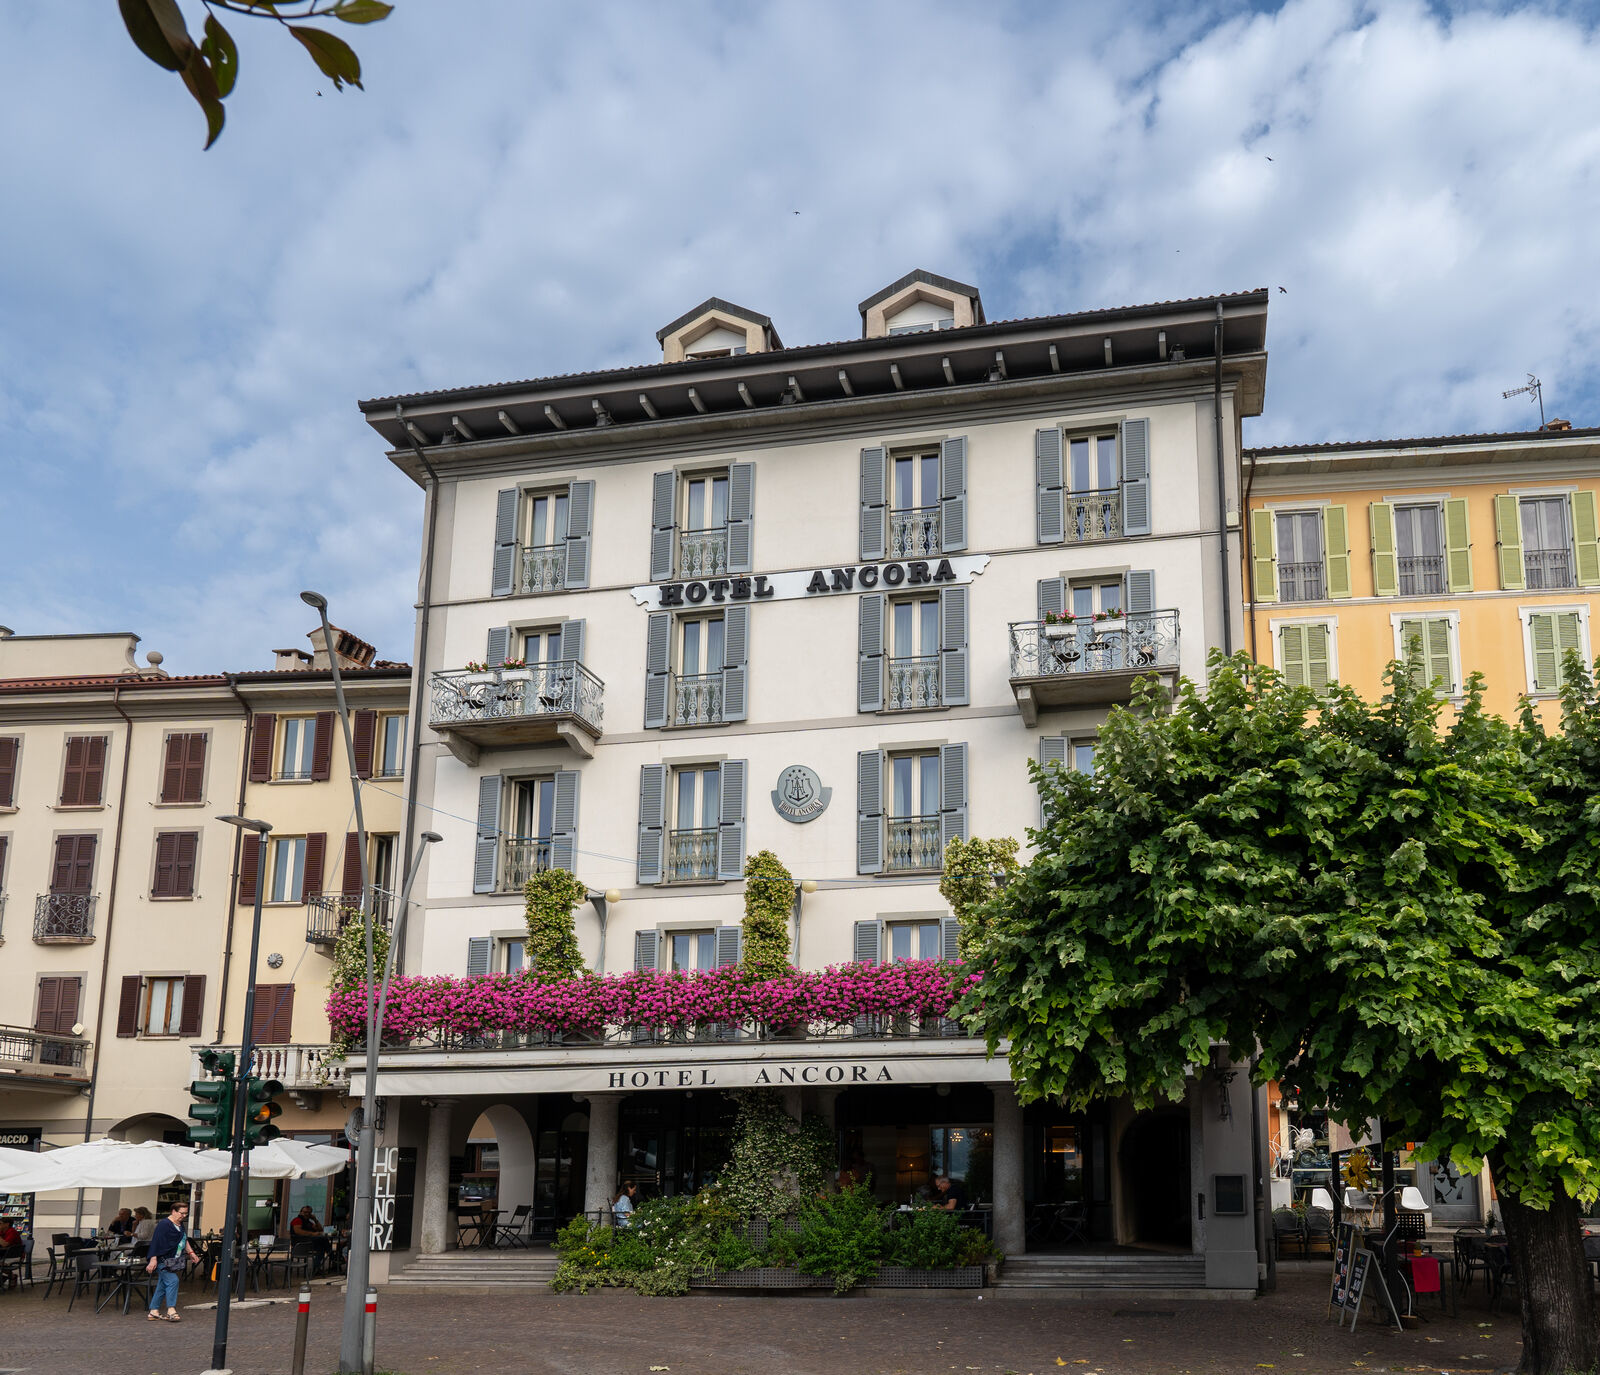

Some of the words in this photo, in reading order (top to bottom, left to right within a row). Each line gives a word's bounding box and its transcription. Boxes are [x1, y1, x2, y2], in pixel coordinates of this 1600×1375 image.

[659, 576, 774, 605] HOTEL
[807, 559, 956, 592] ANCORA
[798, 800, 823, 816] ANCORA
[608, 1069, 716, 1088] HOTEL
[755, 1065, 893, 1084] ANCORA
[372, 1173, 395, 1198] EL
